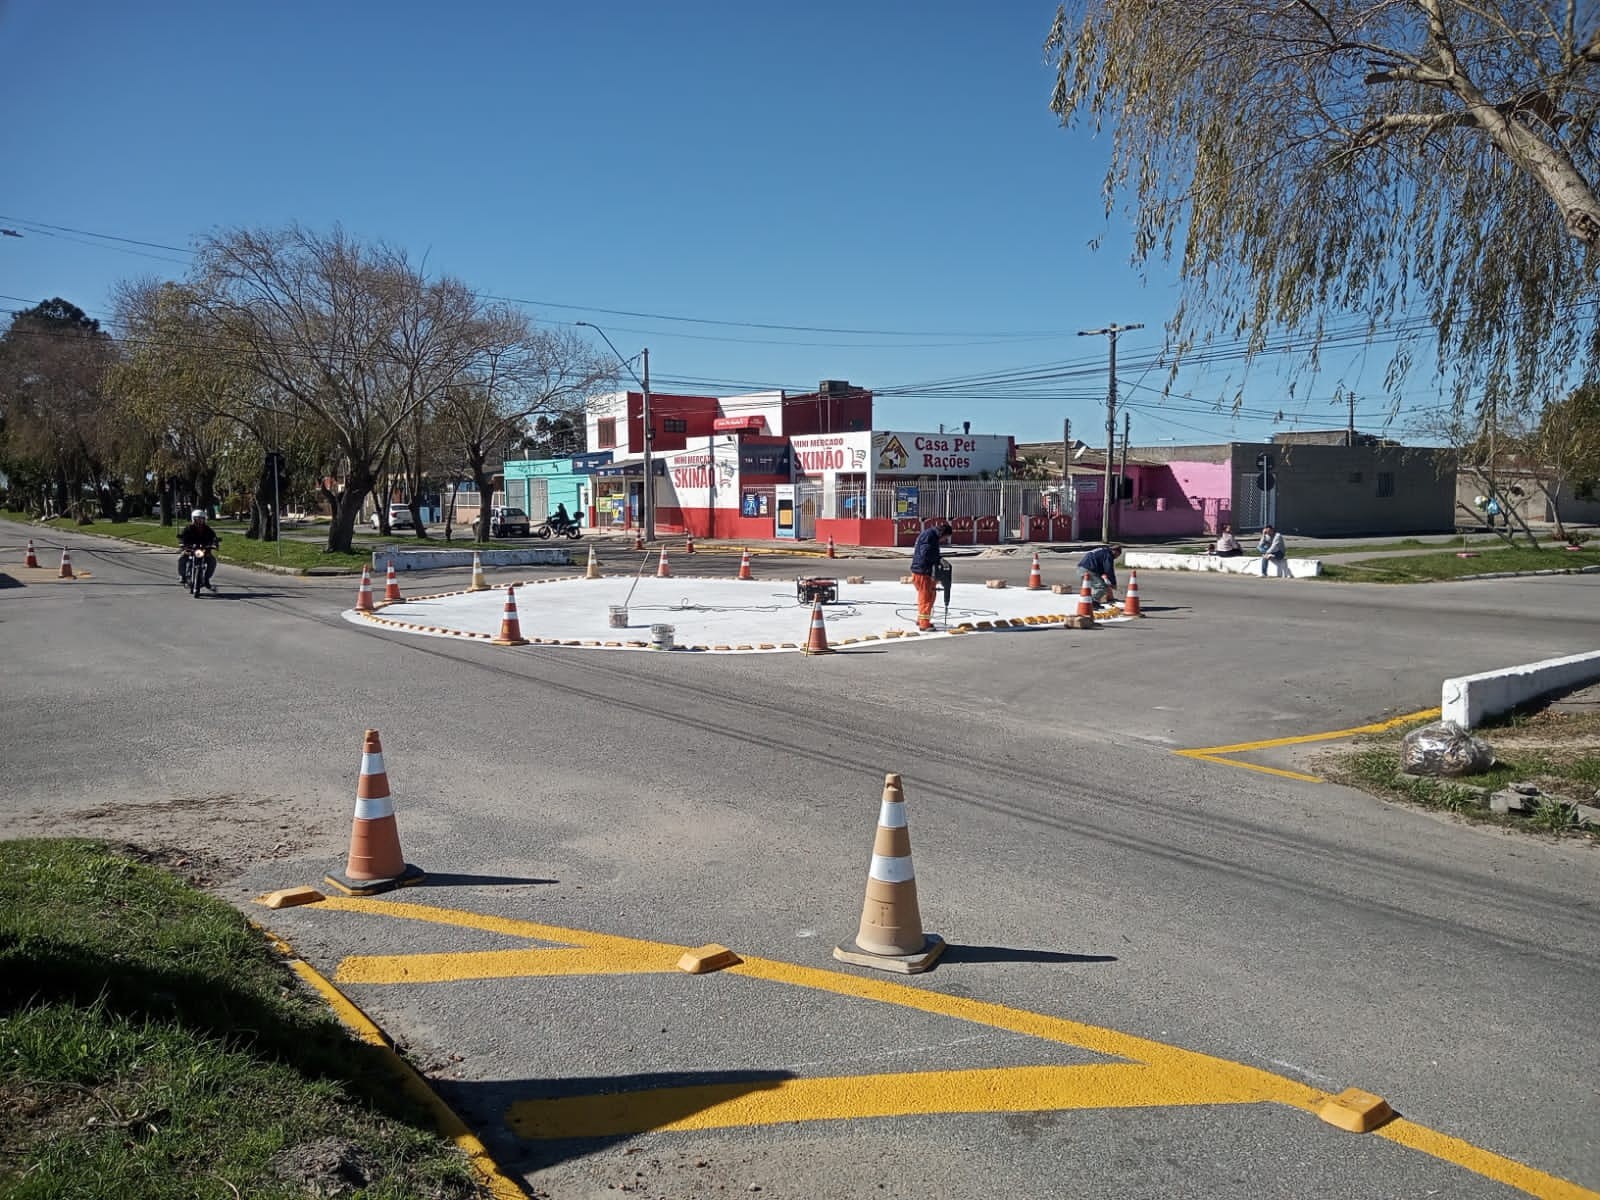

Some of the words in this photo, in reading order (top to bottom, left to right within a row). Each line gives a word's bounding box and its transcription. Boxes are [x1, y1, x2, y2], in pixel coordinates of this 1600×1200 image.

[794, 440, 808, 448] MINI
[810, 438, 844, 447] MERCADO
[914, 436, 949, 451] Casa
[953, 438, 977, 452] Pet
[673, 455, 687, 465] MINI
[794, 446, 844, 471] SKINÃO
[923, 453, 970, 471] Rações
[674, 464, 716, 489] SKINÃO
